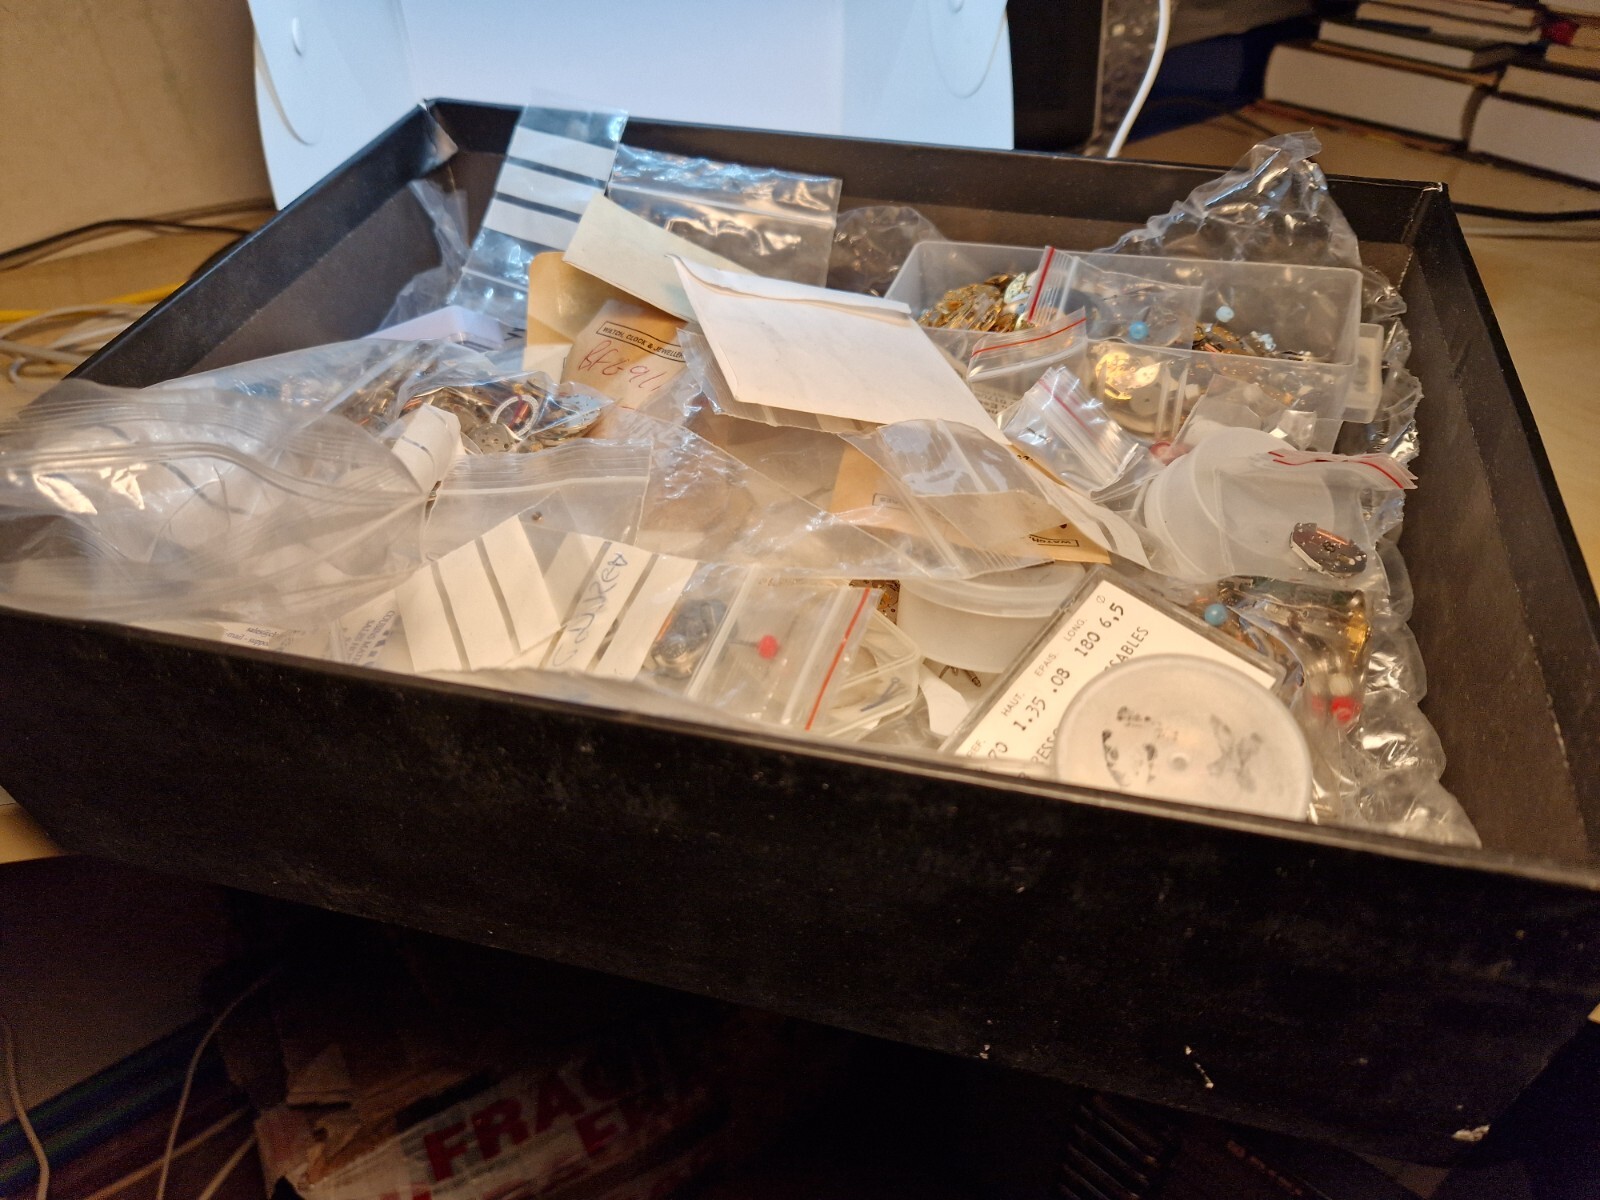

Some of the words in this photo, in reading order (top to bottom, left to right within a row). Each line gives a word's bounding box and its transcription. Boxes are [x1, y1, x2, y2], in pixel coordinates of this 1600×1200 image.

[626, 334, 647, 346] CLOCK
[653, 346, 685, 359] JEWELLER
[1001, 692, 1026, 717] HAUT.
[1063, 617, 1088, 642] LONG.
[1013, 696, 1046, 731] 1.35
[1051, 668, 1071, 693] .08
[1074, 631, 1101, 657] 180
[1099, 602, 1124, 629] 6,5
[1104, 625, 1149, 672] SABLES
